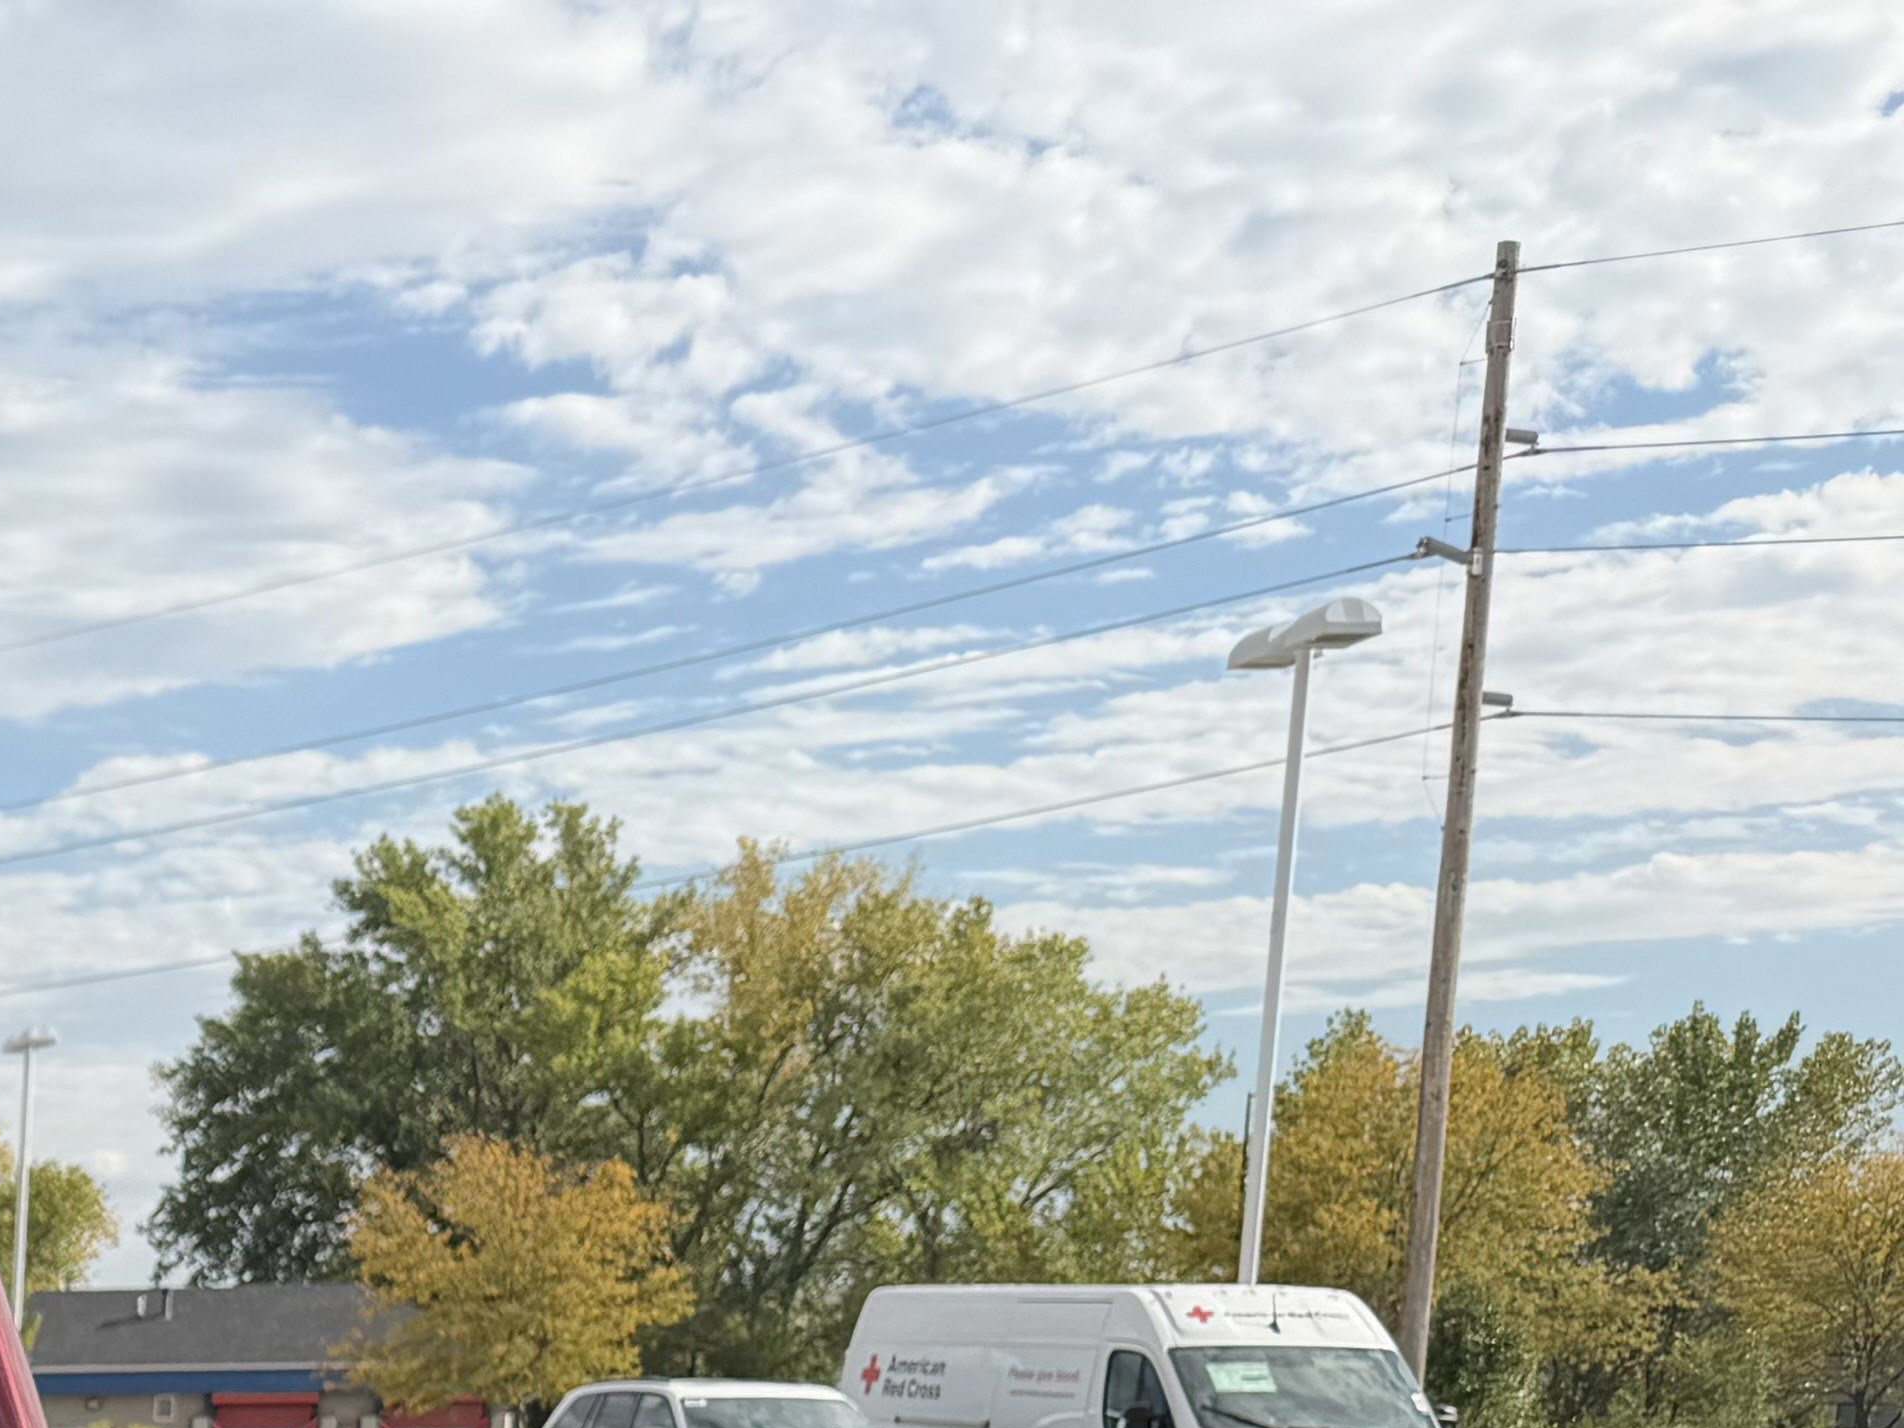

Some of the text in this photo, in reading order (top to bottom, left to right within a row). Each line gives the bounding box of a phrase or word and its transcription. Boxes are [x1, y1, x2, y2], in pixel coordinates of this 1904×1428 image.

[887, 1354, 946, 1377] American
[882, 1376, 941, 1400] Red Cross
